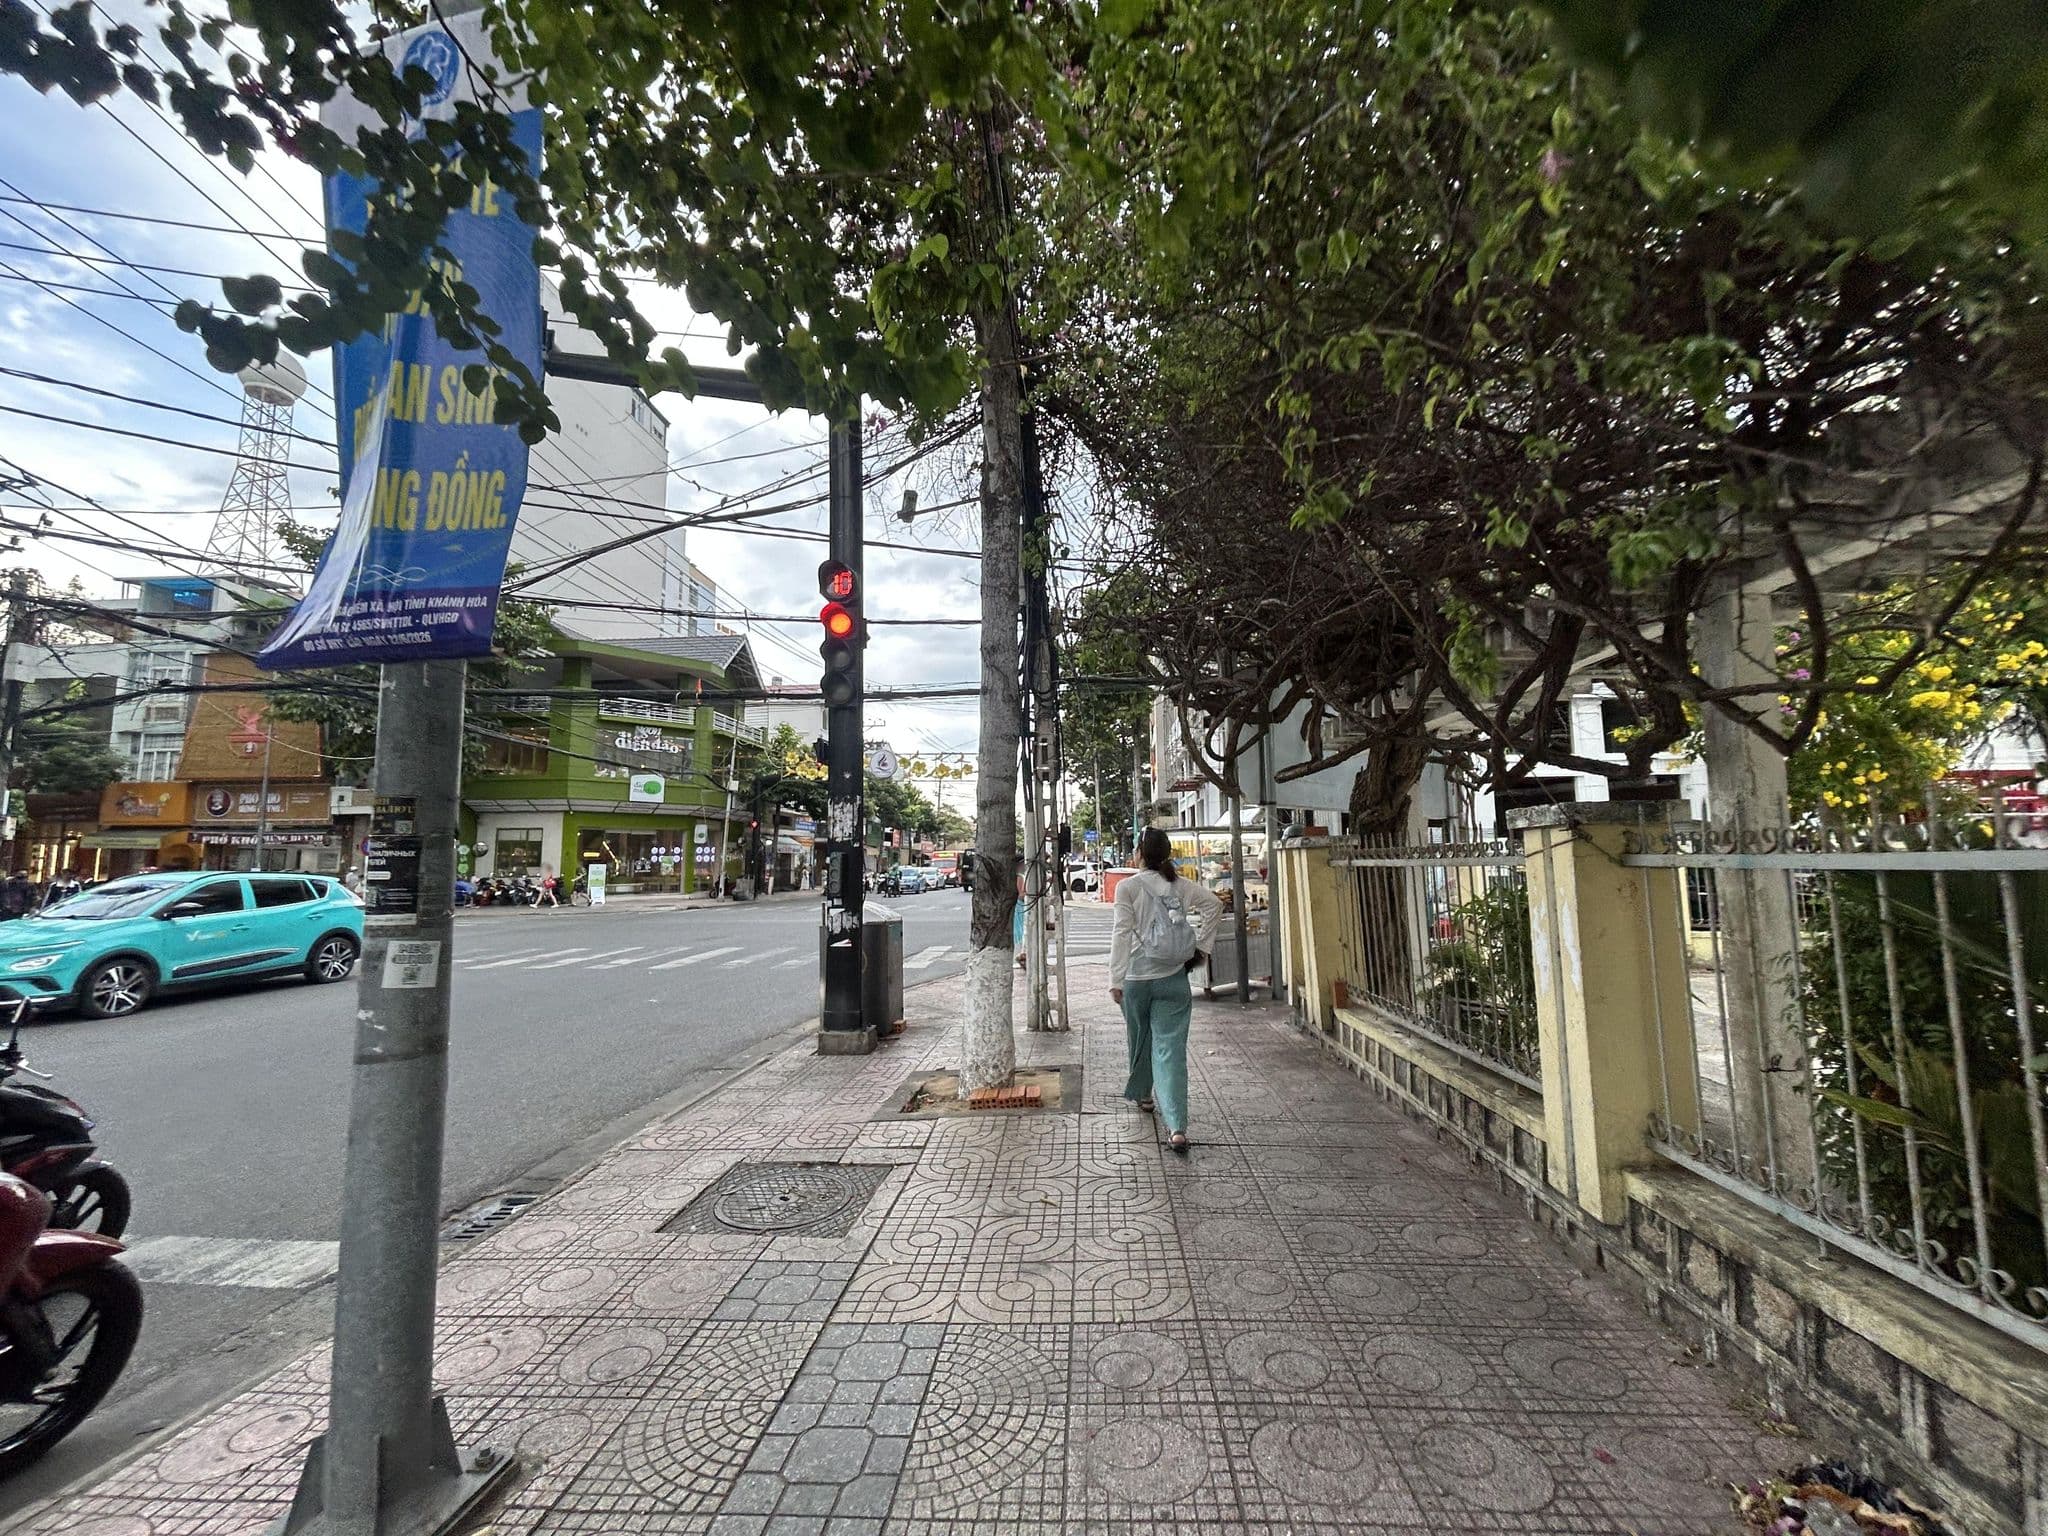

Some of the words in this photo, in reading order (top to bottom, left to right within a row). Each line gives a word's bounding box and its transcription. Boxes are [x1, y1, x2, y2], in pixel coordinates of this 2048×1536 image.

[373, 467, 422, 532] NG
[424, 449, 507, 532] ĐỒNG.
[428, 594, 466, 608] KHÁNH
[466, 593, 488, 608] HÒA
